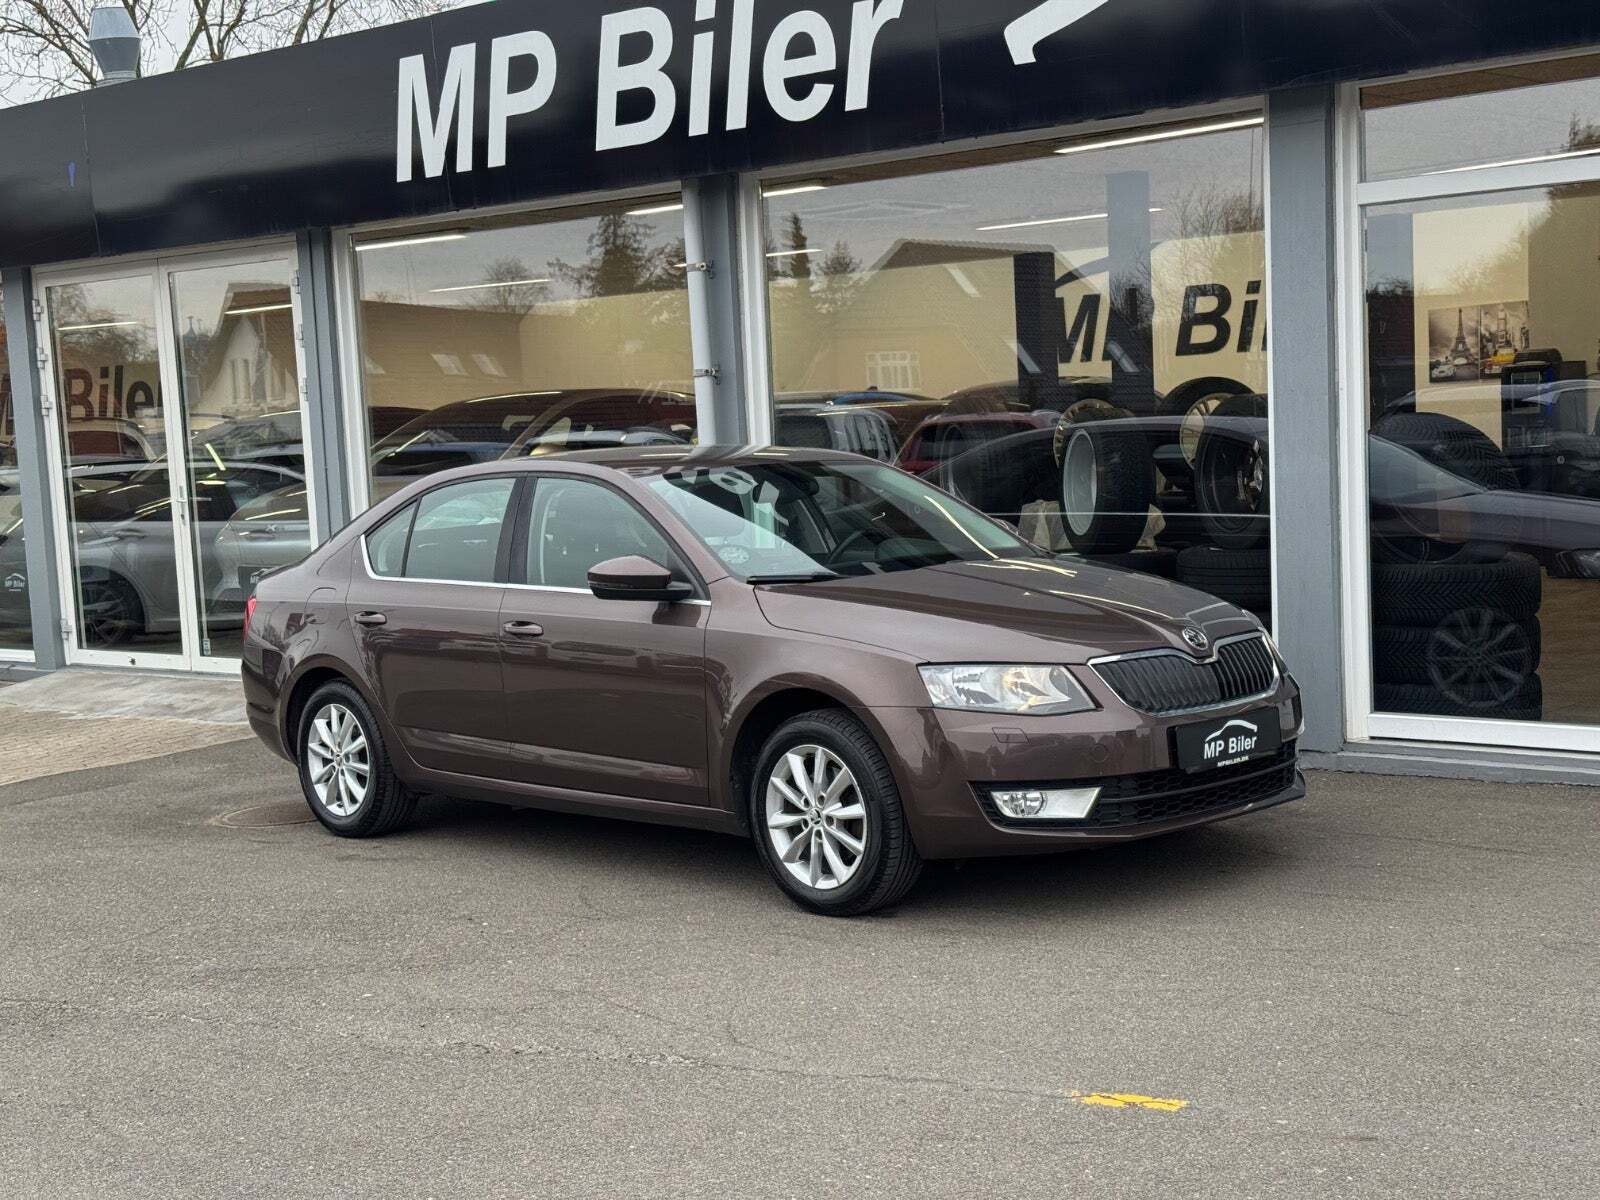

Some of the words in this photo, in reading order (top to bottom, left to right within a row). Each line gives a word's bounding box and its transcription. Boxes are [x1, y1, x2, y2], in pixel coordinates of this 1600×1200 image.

[396, 29, 557, 183] MP
[595, 0, 903, 152] Biler
[1204, 740, 1225, 760] MP
[1229, 736, 1257, 754] Biler
